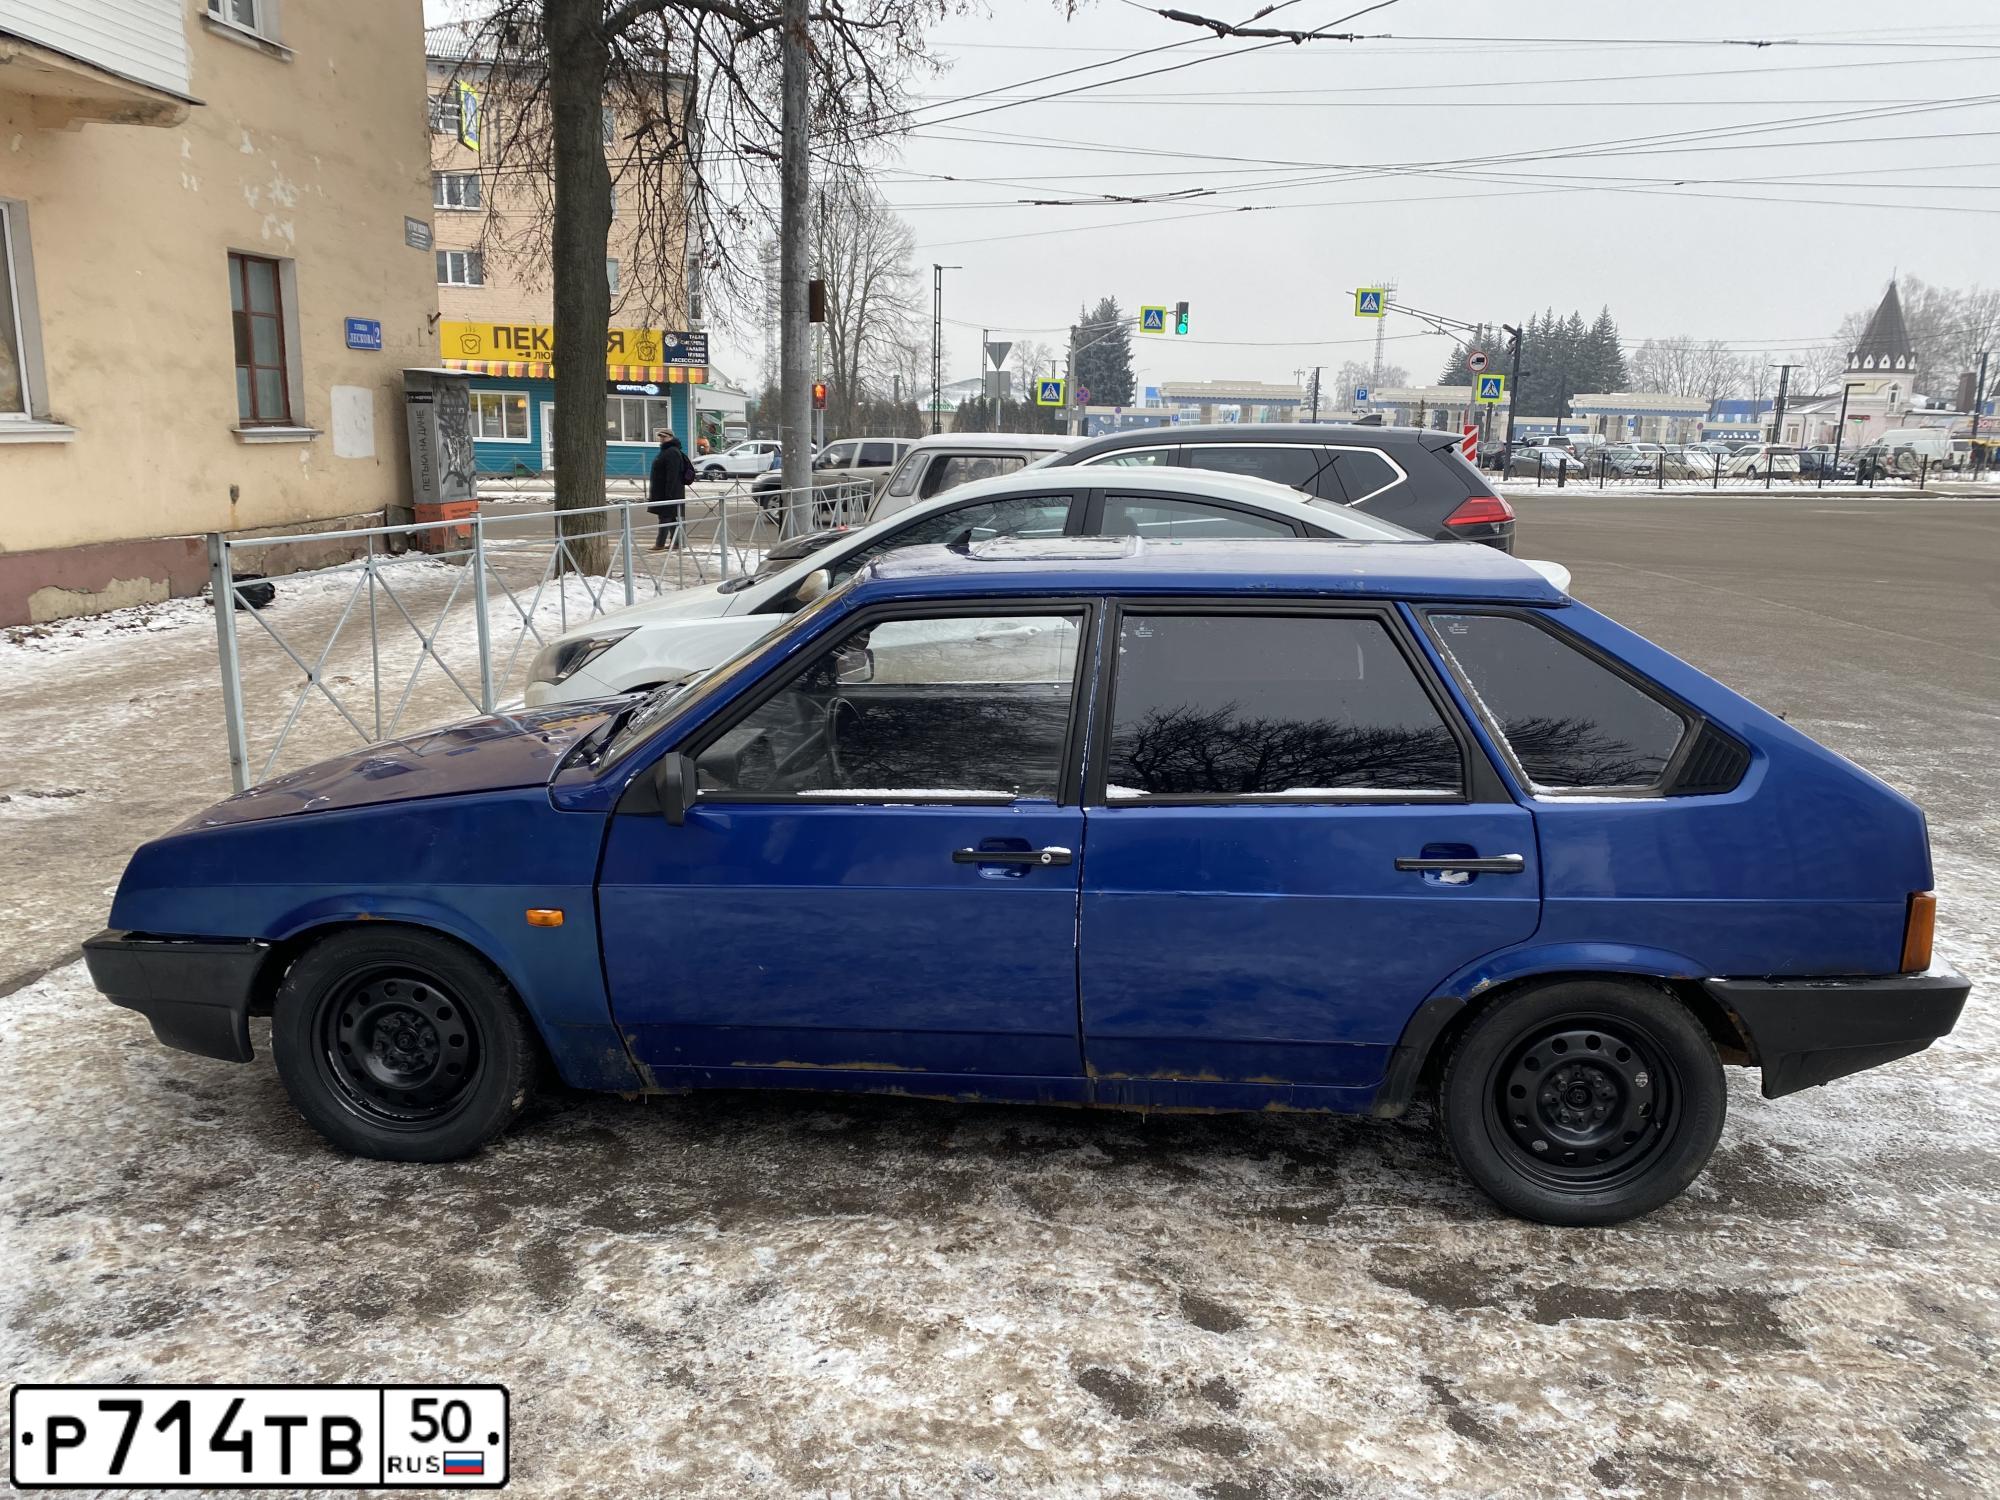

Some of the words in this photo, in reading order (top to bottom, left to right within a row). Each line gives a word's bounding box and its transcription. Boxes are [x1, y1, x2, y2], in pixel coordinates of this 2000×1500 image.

[349, 332, 375, 345] ЛЕСКОВА
[374, 327, 381, 343] 2
[493, 326, 625, 354] ПЕКЯ
[418, 439, 428, 452] НА
